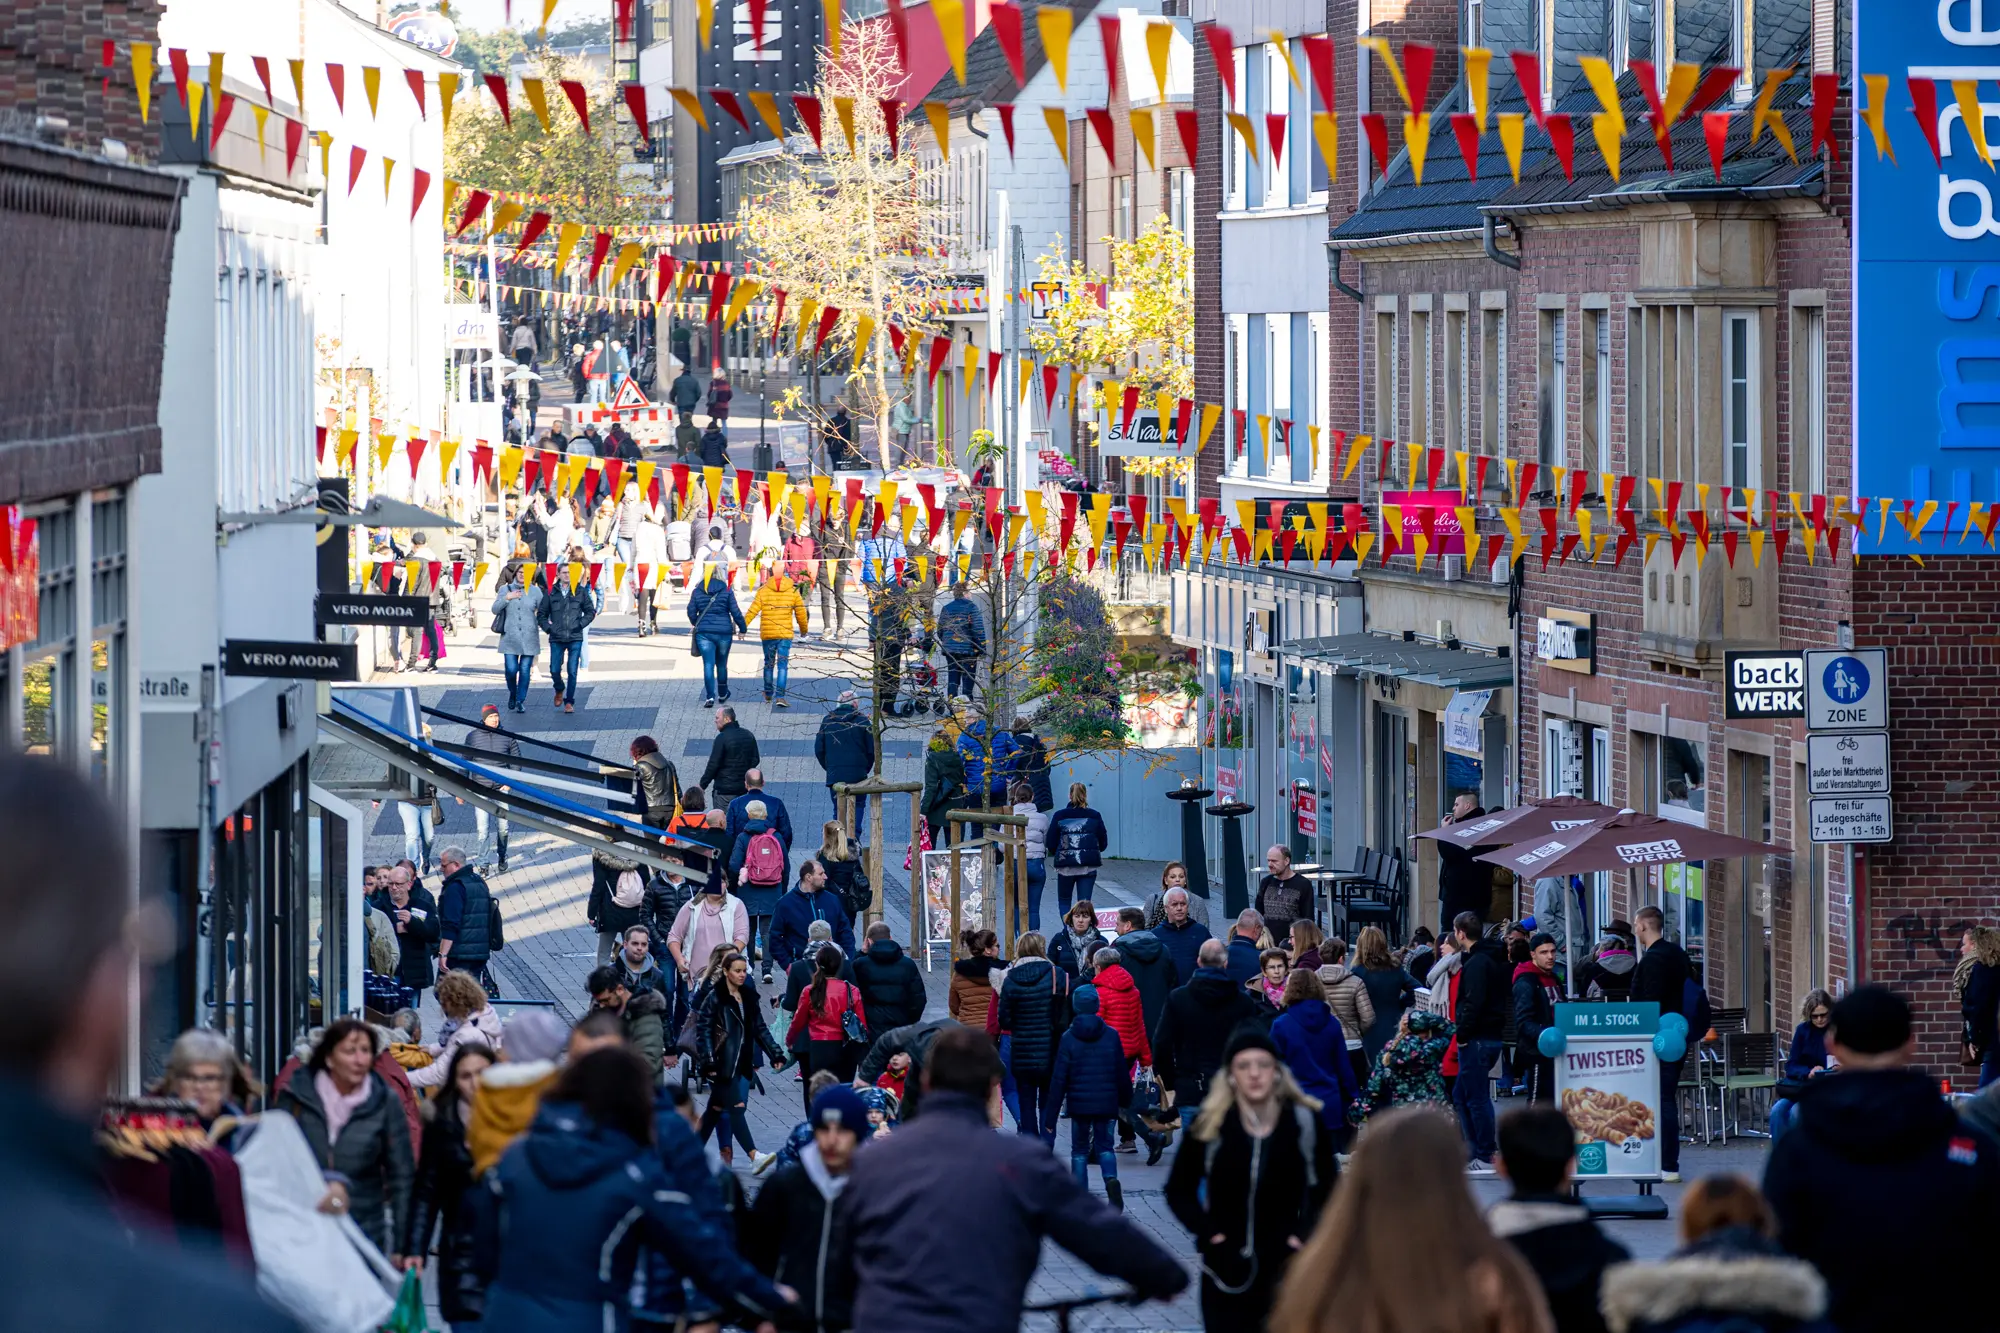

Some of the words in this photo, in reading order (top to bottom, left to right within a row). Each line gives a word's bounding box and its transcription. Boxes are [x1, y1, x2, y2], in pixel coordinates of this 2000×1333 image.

[457, 319, 485, 335] dm
[332, 604, 369, 616] VERO
[372, 605, 414, 617] MODA
[242, 652, 286, 666] VERO
[289, 654, 340, 668] MODA
[1739, 661, 1800, 685] back
[1734, 691, 1804, 712] WERK
[1827, 709, 1867, 723] ZONE
[1842, 756, 1854, 766] frei
[1812, 768, 1831, 778] außer
[1832, 767, 1843, 777] bei
[1844, 766, 1884, 777] Marktbetrieb
[1816, 779, 1829, 790] und
[1830, 778, 1882, 790] Veranstaltungen
[1835, 801, 1849, 811] frei
[1851, 800, 1865, 810] für
[1818, 812, 1882, 825] Ladegeschäfte
[1871, 825, 1886, 836] 15h
[1618, 841, 1679, 856] back
[1622, 850, 1687, 864] WERK
[1574, 1014, 1589, 1026] IM
[1592, 1014, 1602, 1026] 1.
[1605, 1013, 1640, 1026] STOCK
[1567, 1047, 1645, 1071] TWISTERS
